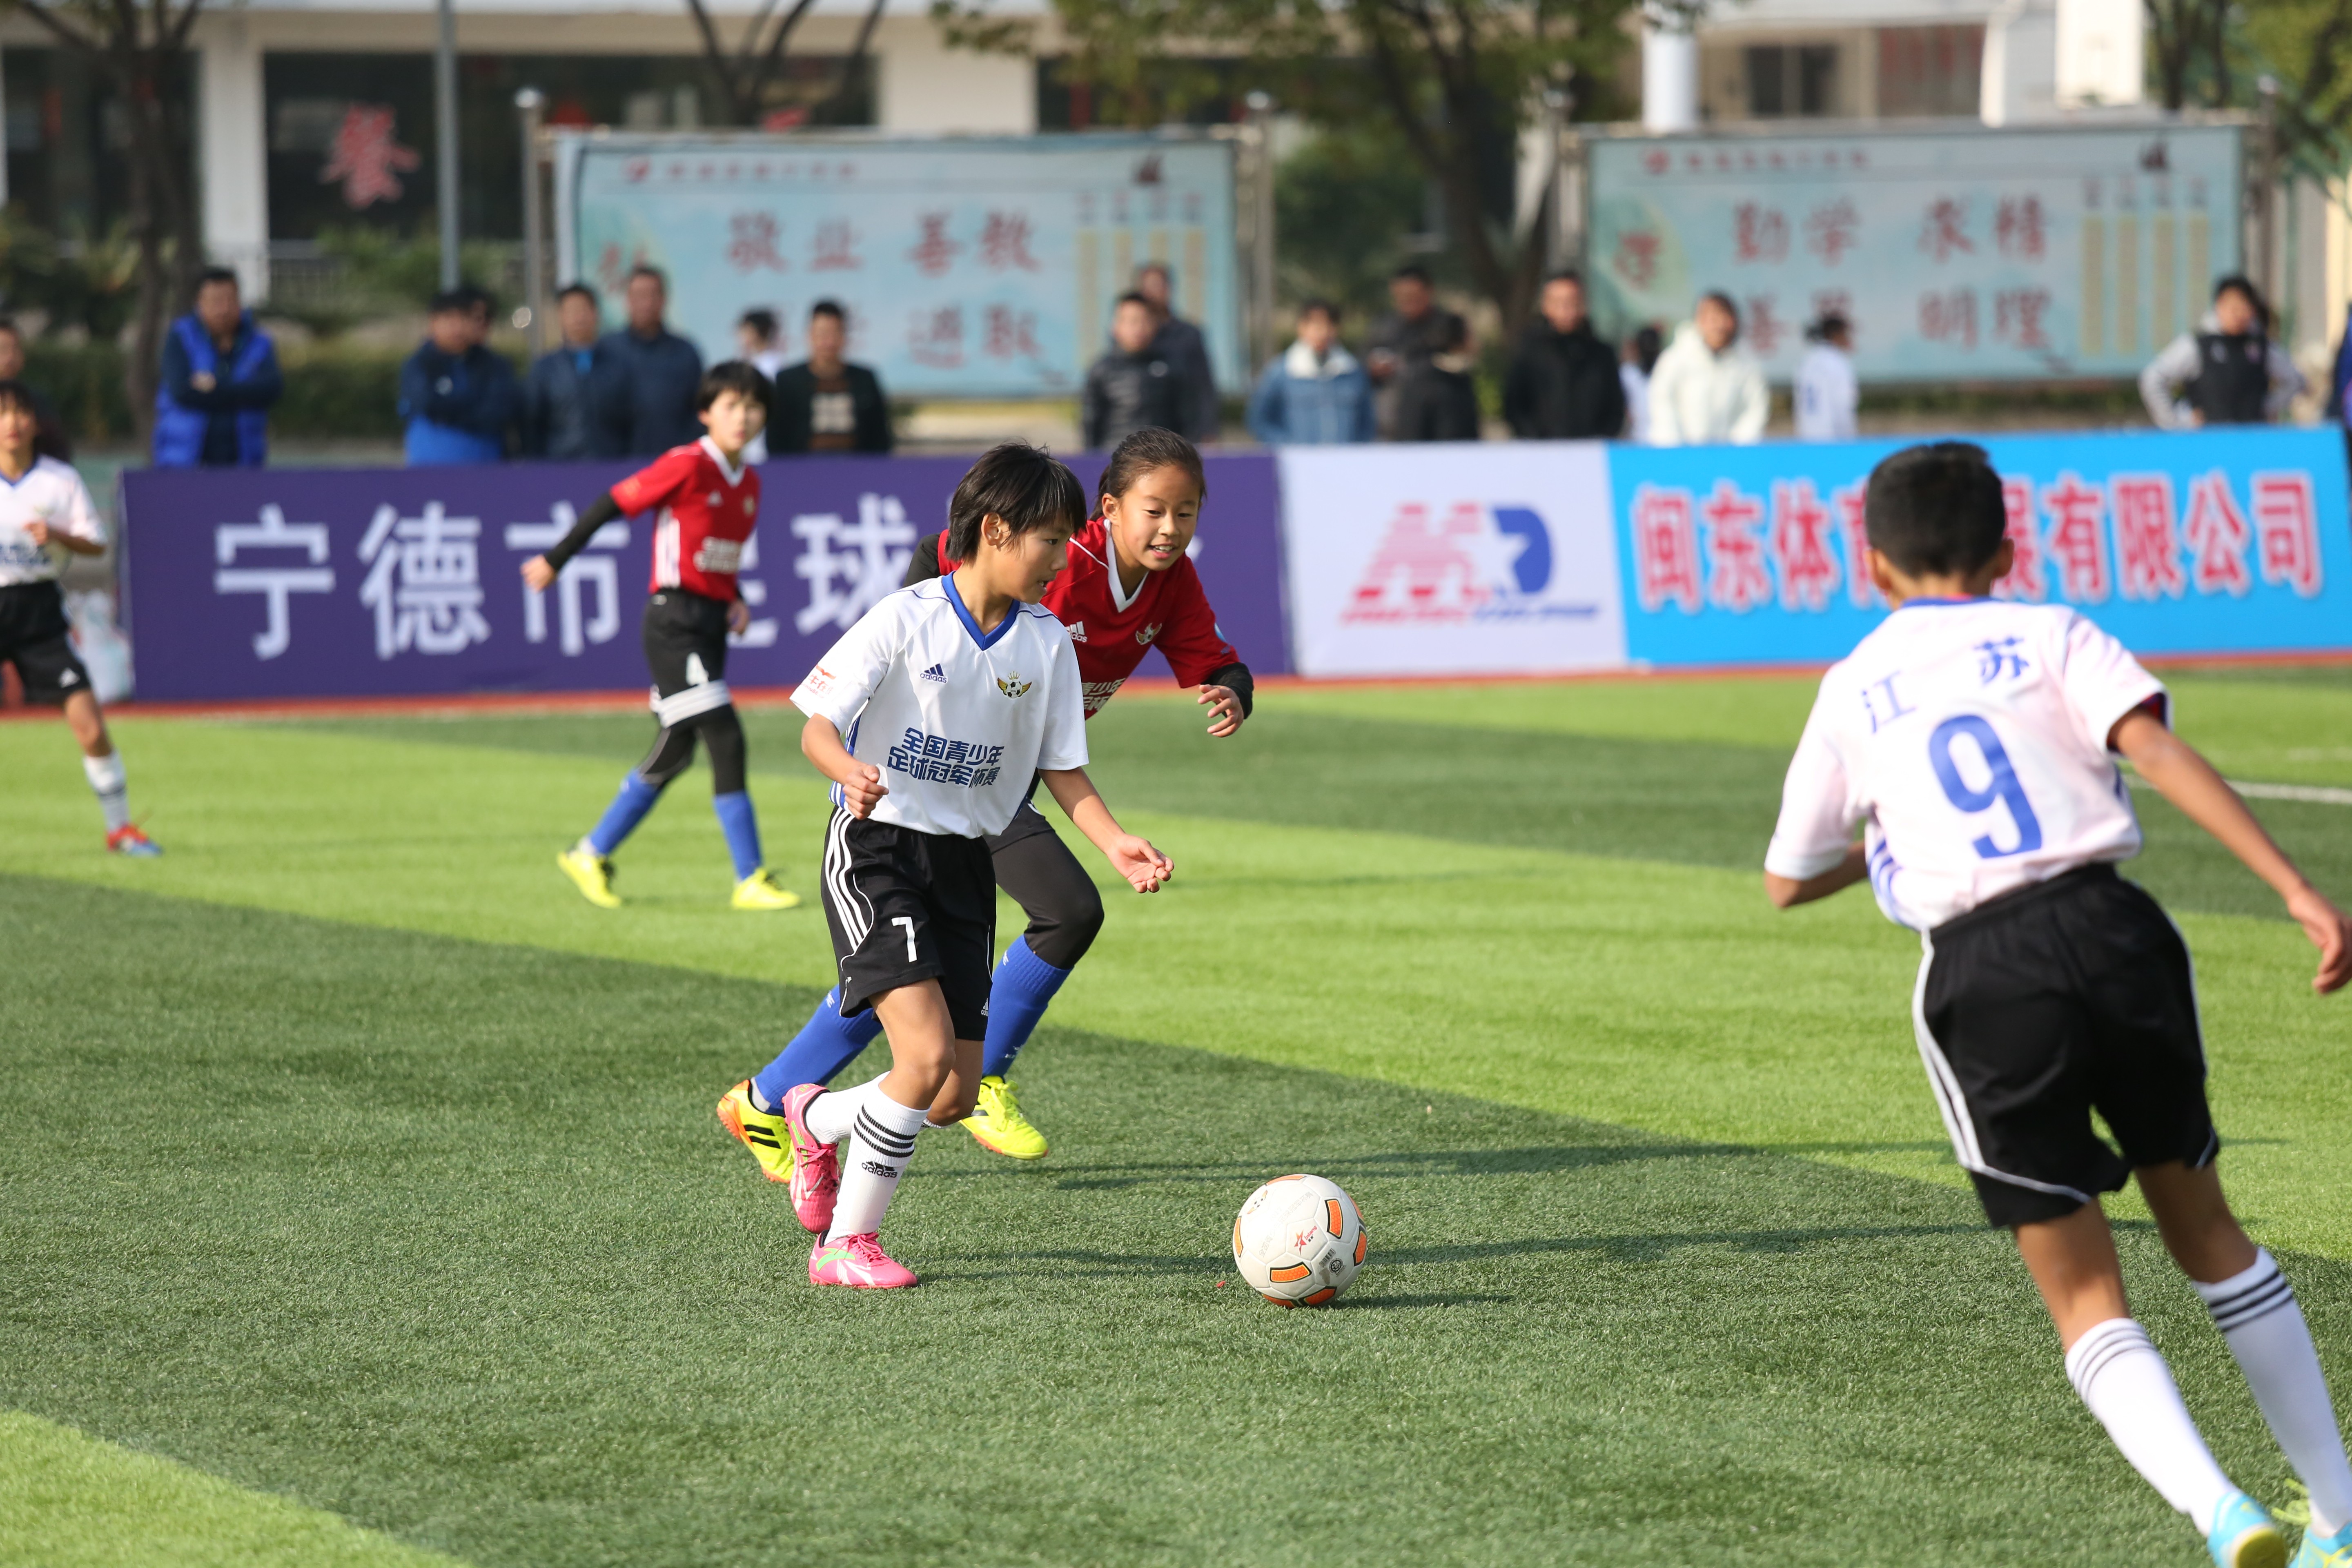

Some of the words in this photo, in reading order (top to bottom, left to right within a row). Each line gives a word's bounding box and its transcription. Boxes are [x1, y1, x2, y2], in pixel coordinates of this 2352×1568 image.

[920, 673, 947, 683] adidas
[901, 727, 1005, 766] 全国青少年
[887, 746, 1001, 788] 足球冠军杯赛
[1929, 714, 2042, 860] 9
[891, 916, 918, 963] 7
[861, 1162, 898, 1178] adidas
